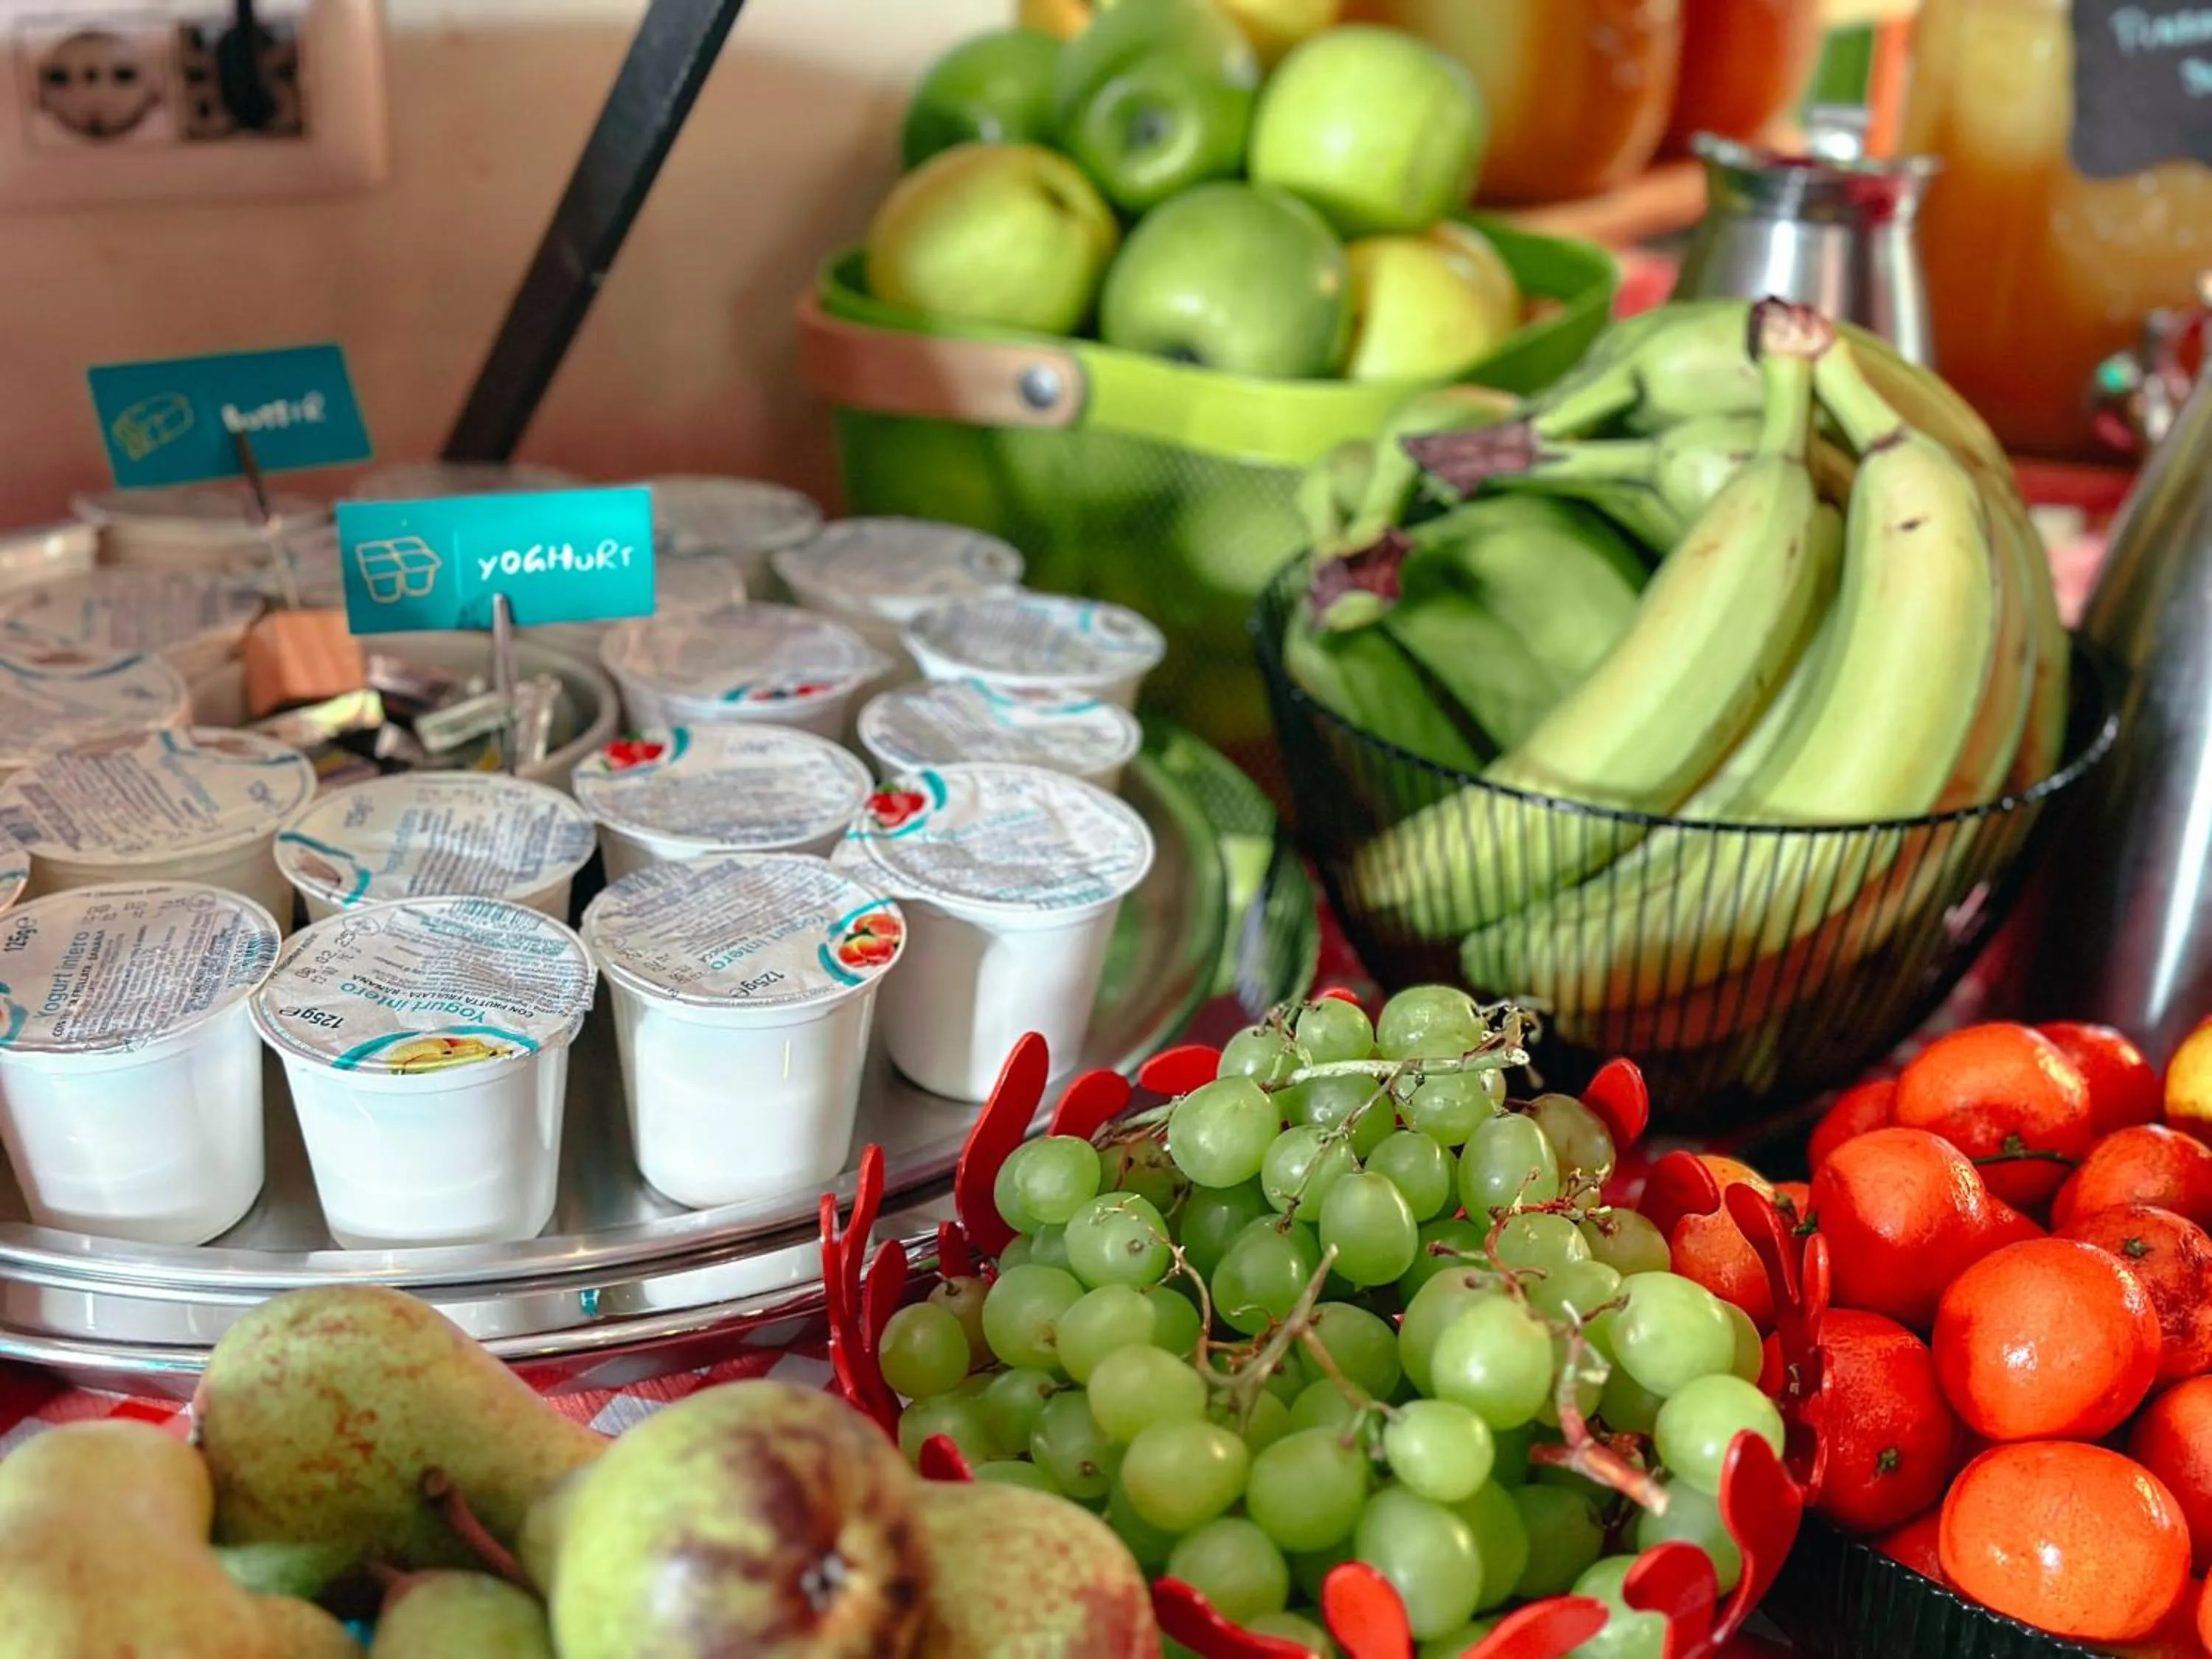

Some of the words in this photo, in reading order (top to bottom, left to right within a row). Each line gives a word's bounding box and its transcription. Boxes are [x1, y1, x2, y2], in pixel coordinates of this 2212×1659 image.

[341, 982, 408, 1012] intero
[410, 1001, 486, 1023] Yogurt
[509, 1005, 534, 1018] CON
